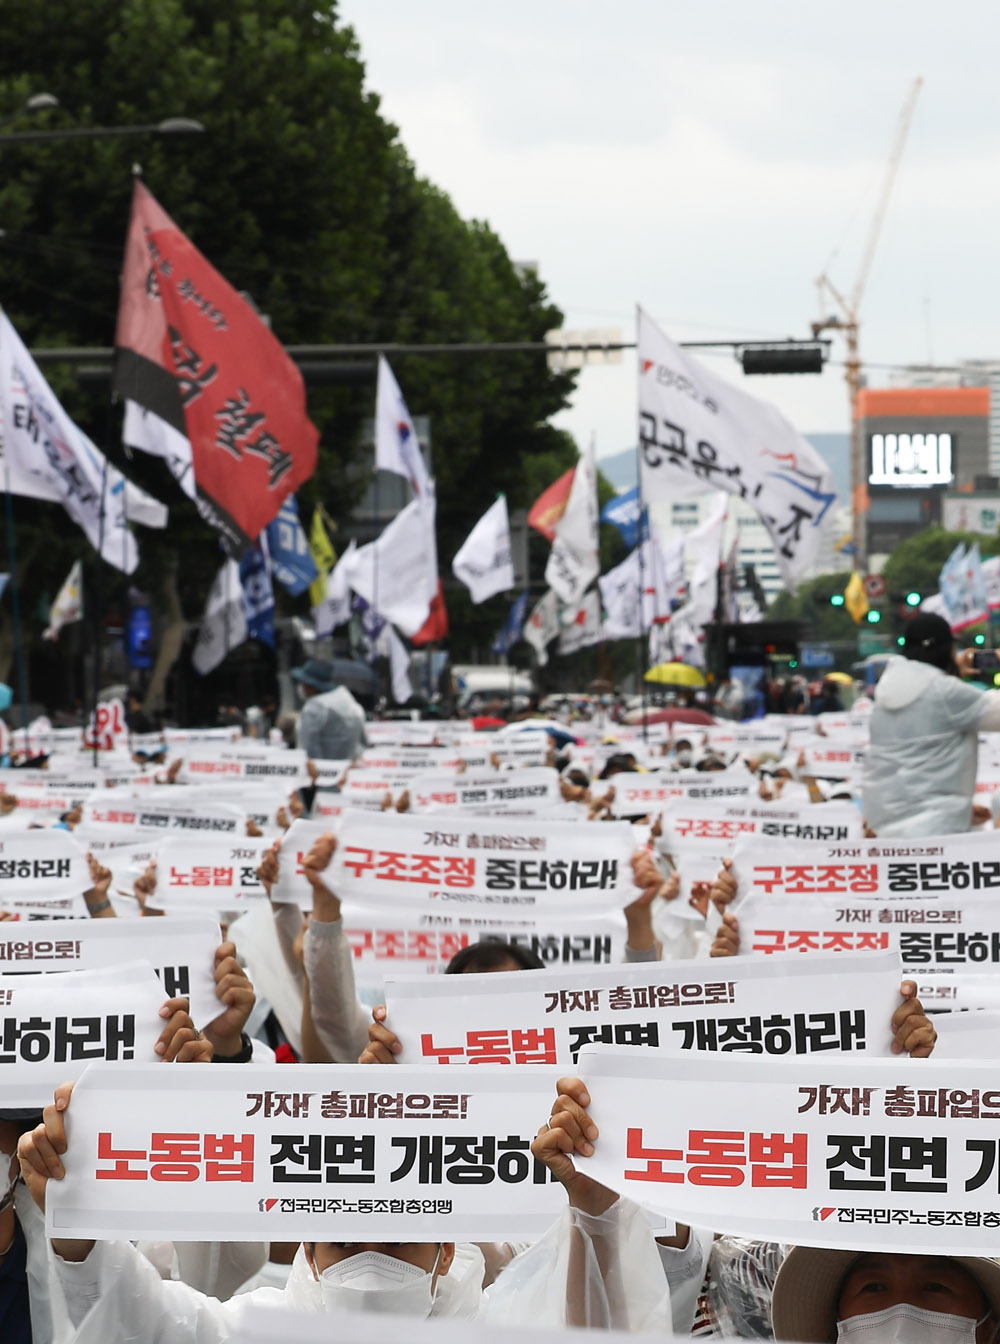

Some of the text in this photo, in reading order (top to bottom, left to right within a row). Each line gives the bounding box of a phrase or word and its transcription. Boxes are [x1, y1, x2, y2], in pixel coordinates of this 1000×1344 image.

[91, 809, 137, 825] 노동법
[139, 814, 169, 828] 전면
[423, 831, 547, 851] 가자! 총파업으로!
[169, 865, 261, 887] 노동법 전
[343, 846, 618, 890] 구조조정 중단하라!
[753, 863, 879, 893] 구조조정
[835, 908, 962, 924] 가자! 총파업으로!
[344, 927, 469, 961] 구조조정
[544, 980, 738, 1014] 가자! 총파업으로!
[420, 1027, 558, 1064] 노동법
[671, 1009, 867, 1055] 개정하라!
[246, 1090, 473, 1120] 가자! 총파업으로!
[797, 1085, 878, 1117] 가자!
[95, 1131, 558, 1185] 노동법 전면 개정하
[624, 1127, 809, 1190] 노동법
[825, 1134, 949, 1194] 전면
[279, 1197, 455, 1216] 전국민주노동조합총연맹
